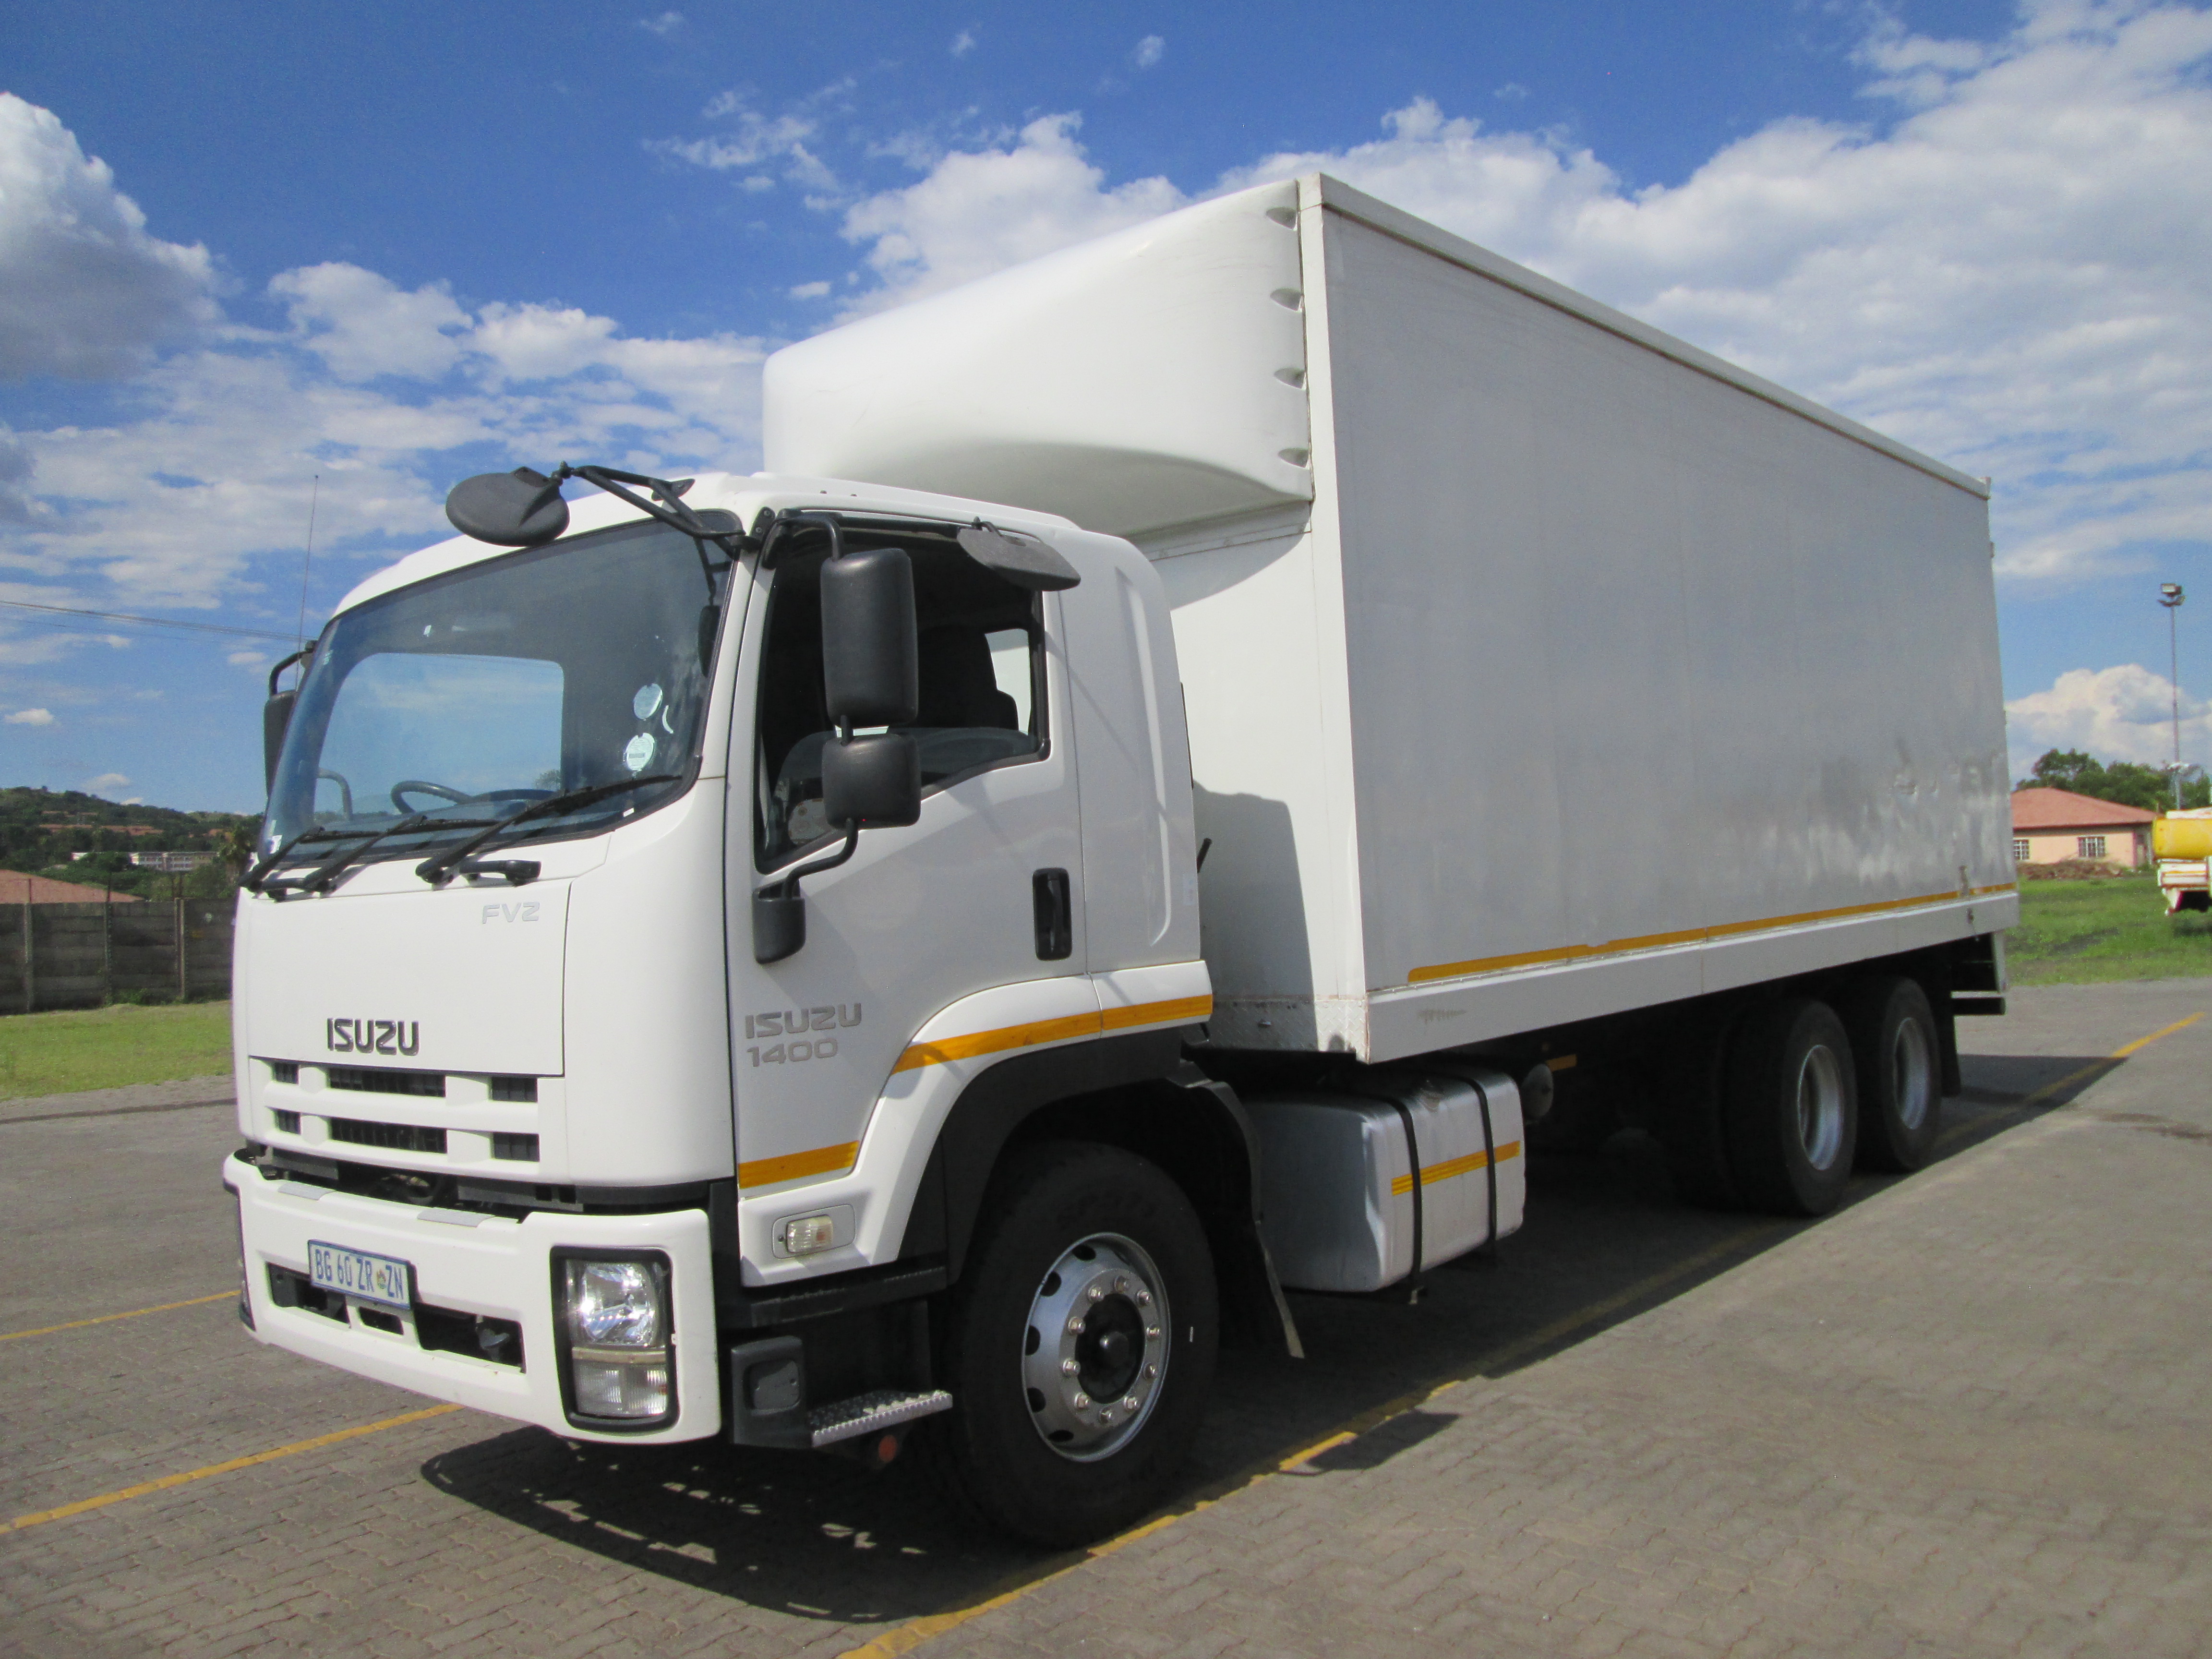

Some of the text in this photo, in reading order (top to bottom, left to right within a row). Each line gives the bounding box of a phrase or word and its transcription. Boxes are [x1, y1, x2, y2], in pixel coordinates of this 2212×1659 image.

[327, 1018, 420, 1056] ISUZU
[745, 1003, 862, 1039] ISUZU
[747, 1037, 838, 1067] 1400
[315, 1249, 404, 1299] BG 60 ZR ZN
